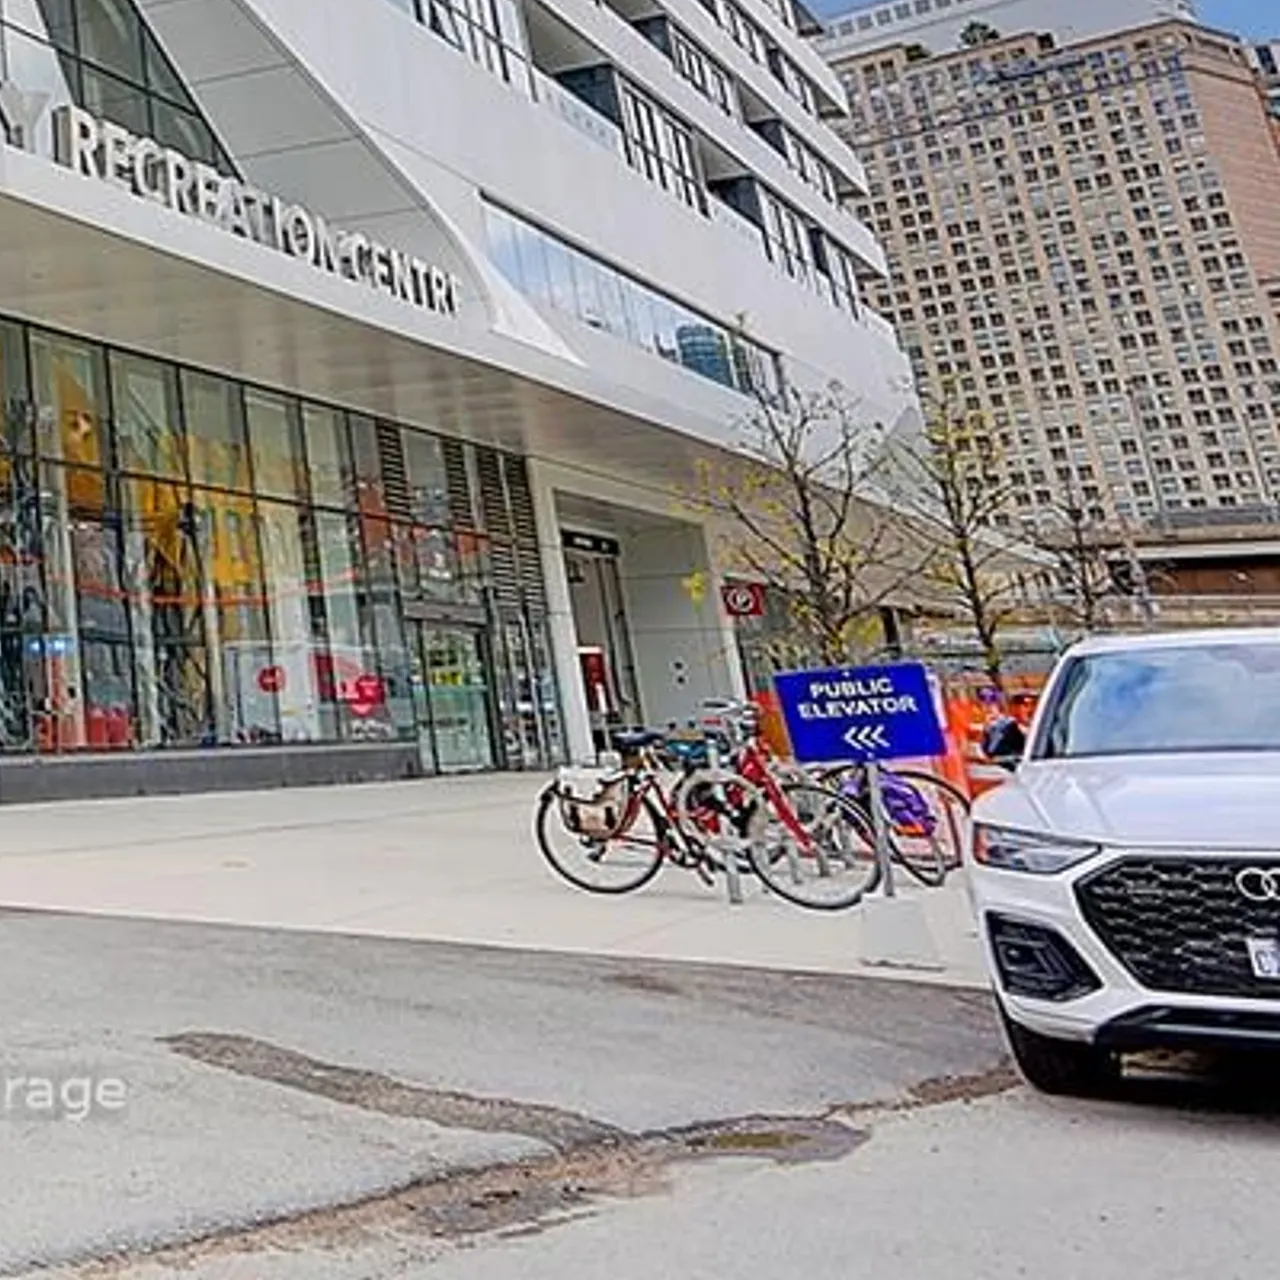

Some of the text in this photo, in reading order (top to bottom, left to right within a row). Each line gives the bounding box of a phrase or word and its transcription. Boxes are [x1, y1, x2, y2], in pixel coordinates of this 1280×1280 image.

[51, 104, 336, 272] RECREATION
[809, 677, 894, 699] PUBLIC
[797, 694, 918, 719] ELEVATOR
